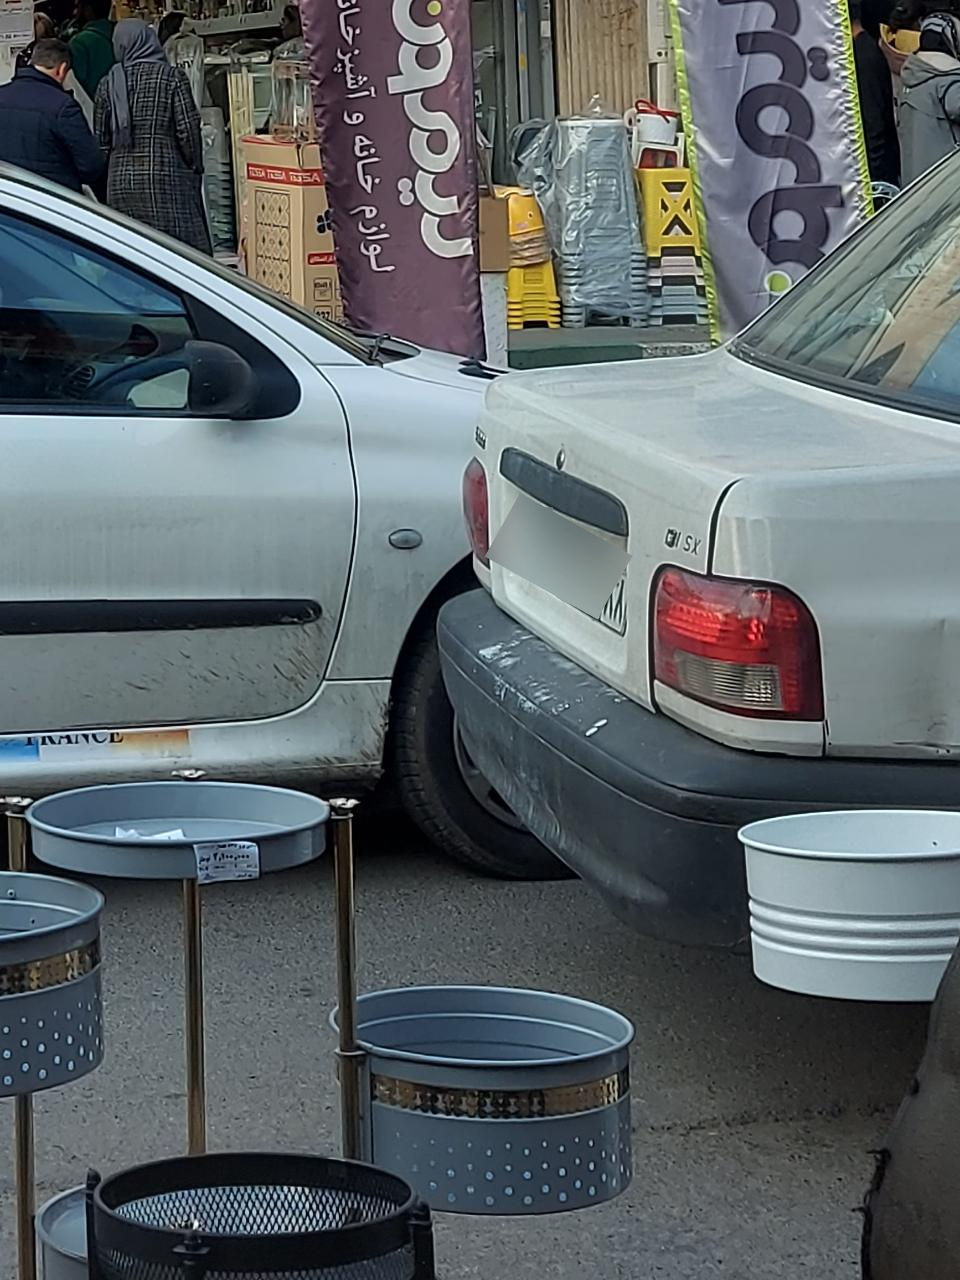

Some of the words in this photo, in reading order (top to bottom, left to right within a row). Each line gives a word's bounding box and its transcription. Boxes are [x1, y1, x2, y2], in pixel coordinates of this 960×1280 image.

[343, 109, 365, 126] و
[353, 134, 385, 196] خانه
[349, 204, 396, 273] لوازم
[683, 535, 702, 555] SX
